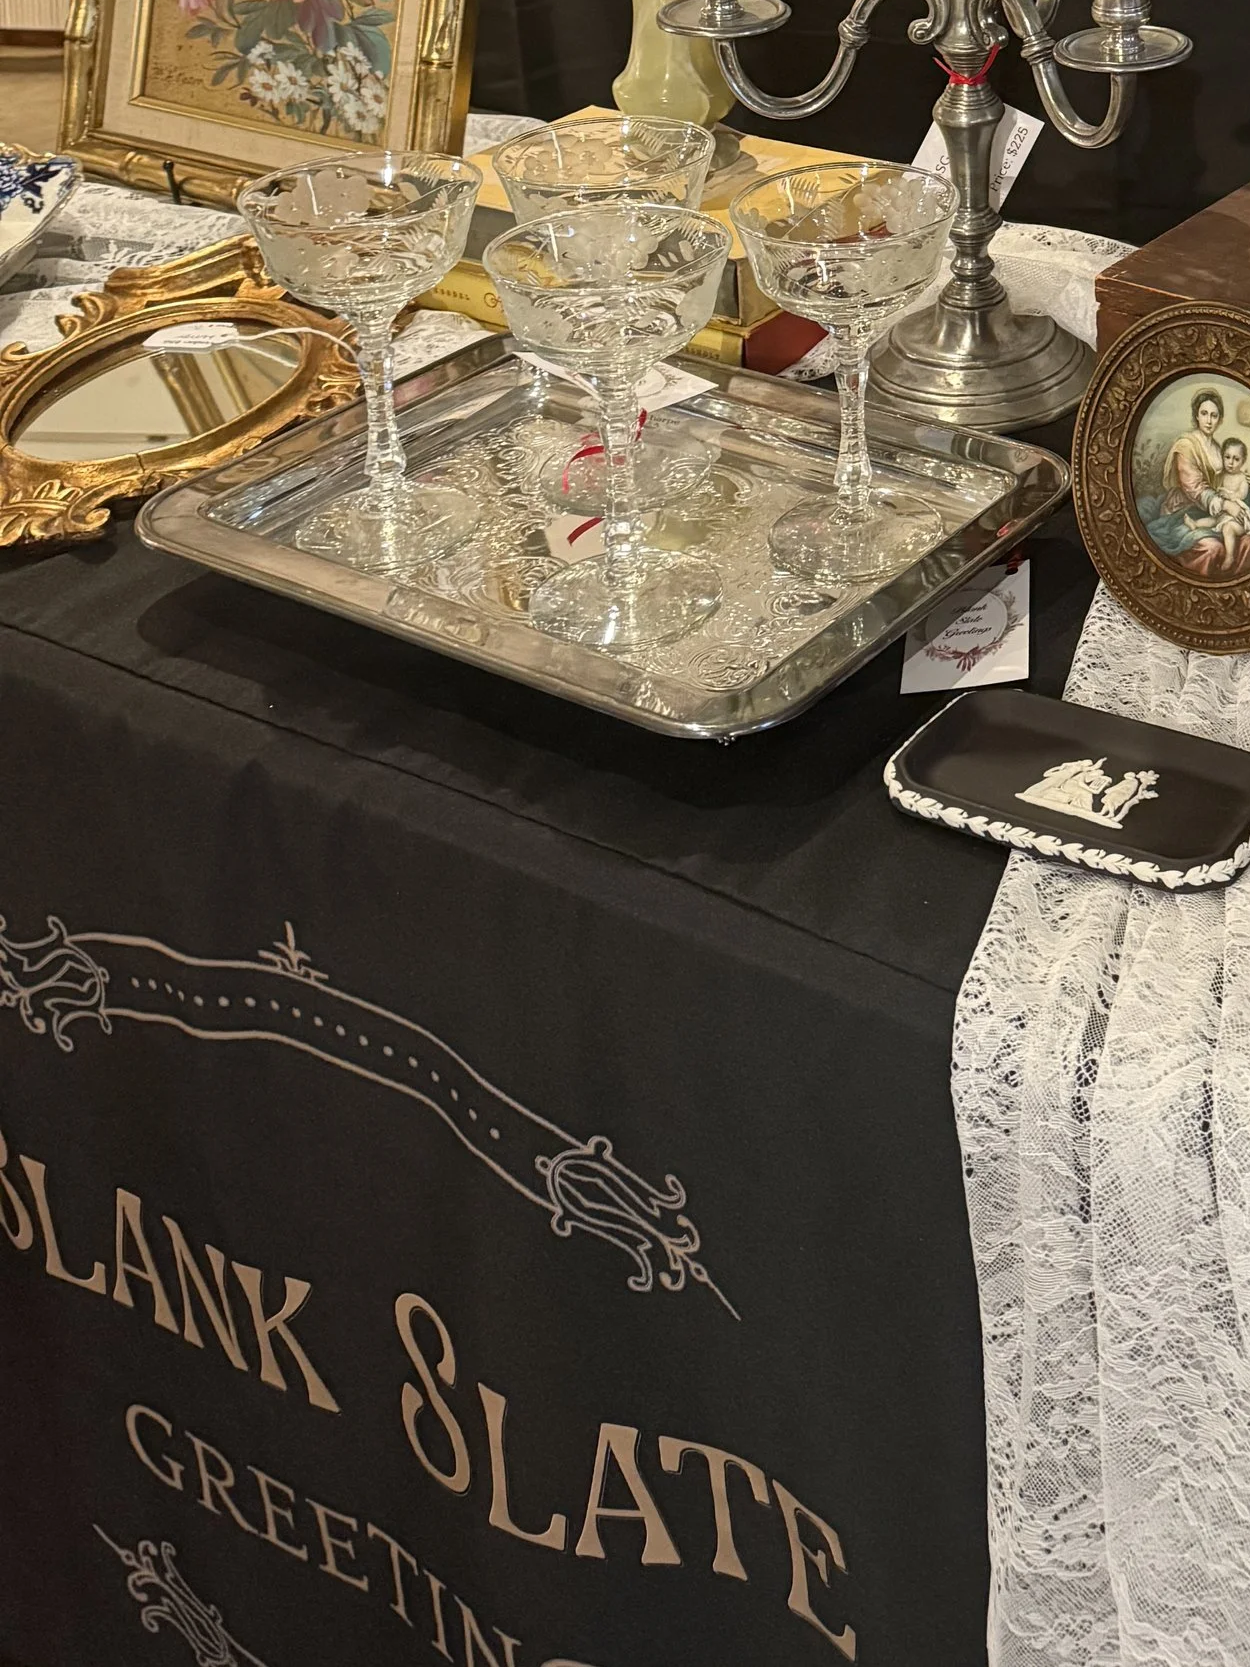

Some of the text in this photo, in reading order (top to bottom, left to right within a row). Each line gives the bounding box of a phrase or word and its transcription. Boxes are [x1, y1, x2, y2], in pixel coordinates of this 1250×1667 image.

[990, 126, 1029, 192] Price: $225
[942, 627, 993, 640] Greetings
[954, 615, 984, 625] Slate
[394, 1292, 858, 1663] SLATE
[124, 1403, 600, 1667] GREETIN
